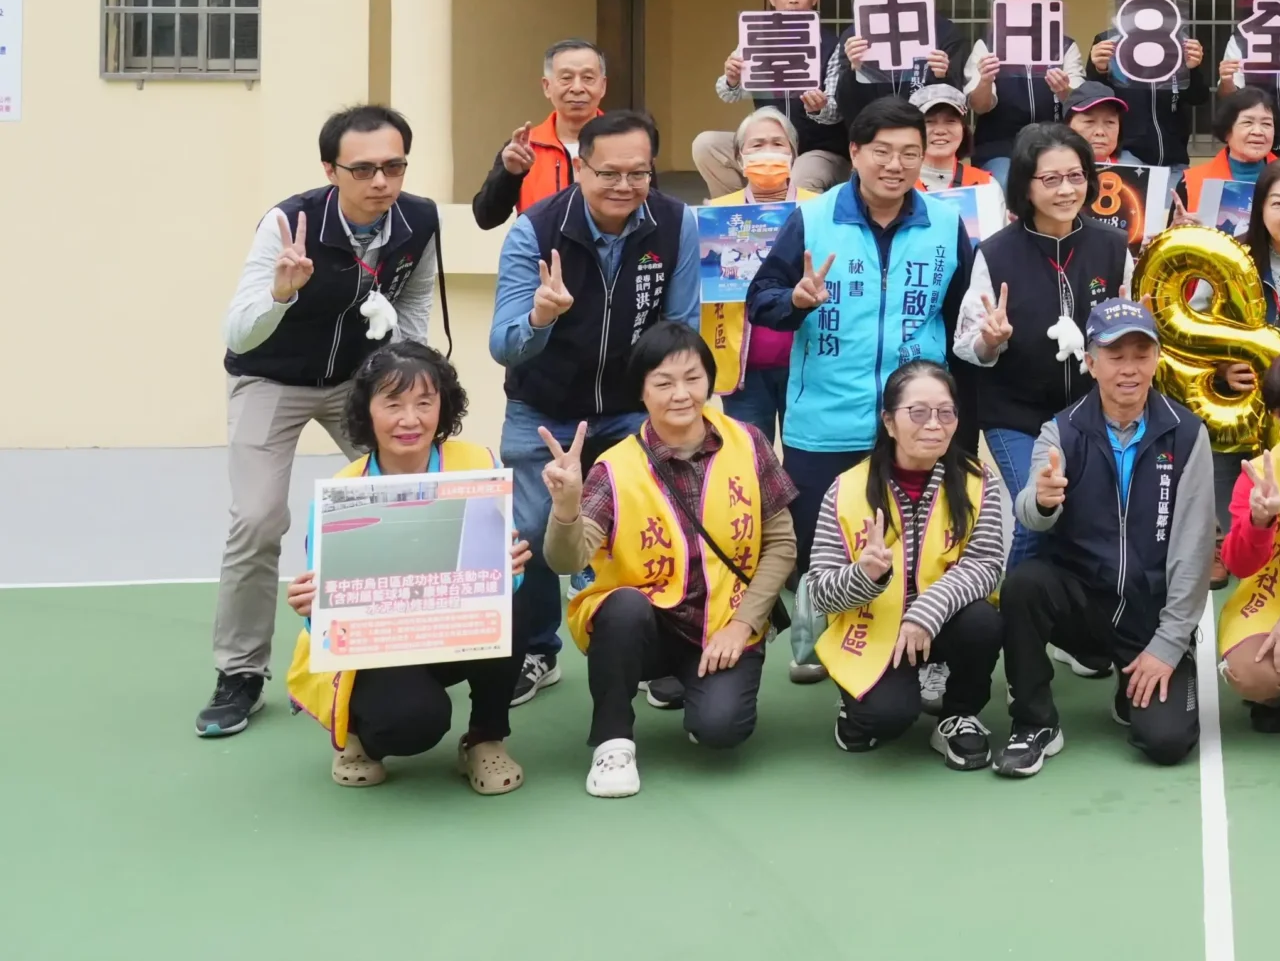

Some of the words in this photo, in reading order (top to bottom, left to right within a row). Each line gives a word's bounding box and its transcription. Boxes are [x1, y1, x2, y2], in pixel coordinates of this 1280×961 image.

[742, 13, 817, 88] 臺
[999, 1, 1062, 62] Hi
[848, 259, 864, 297] 秘書
[818, 280, 841, 357] 劉柏均
[1104, 304, 1121, 315] THE
